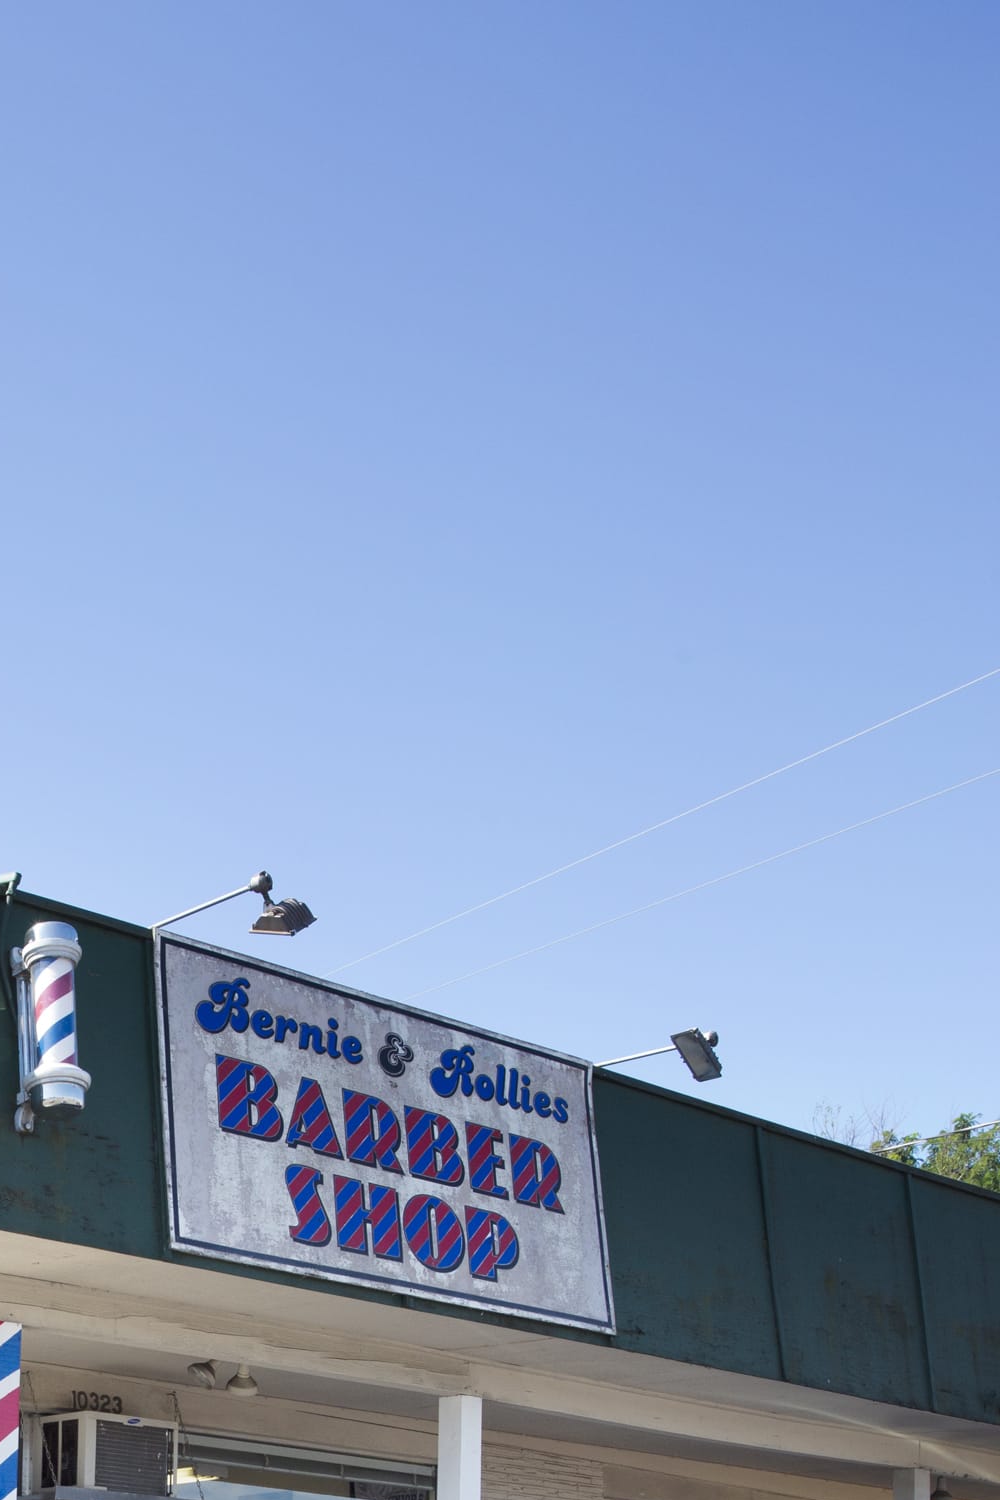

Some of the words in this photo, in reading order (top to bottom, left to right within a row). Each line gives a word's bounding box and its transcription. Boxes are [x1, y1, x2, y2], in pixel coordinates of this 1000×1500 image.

[195, 977, 364, 1065] Bernie
[377, 1032, 413, 1077] &
[429, 1045, 570, 1124] Rollies
[215, 1053, 565, 1215] BARBER
[285, 1163, 520, 1282] SHOP
[71, 1390, 122, 1413] 10323
